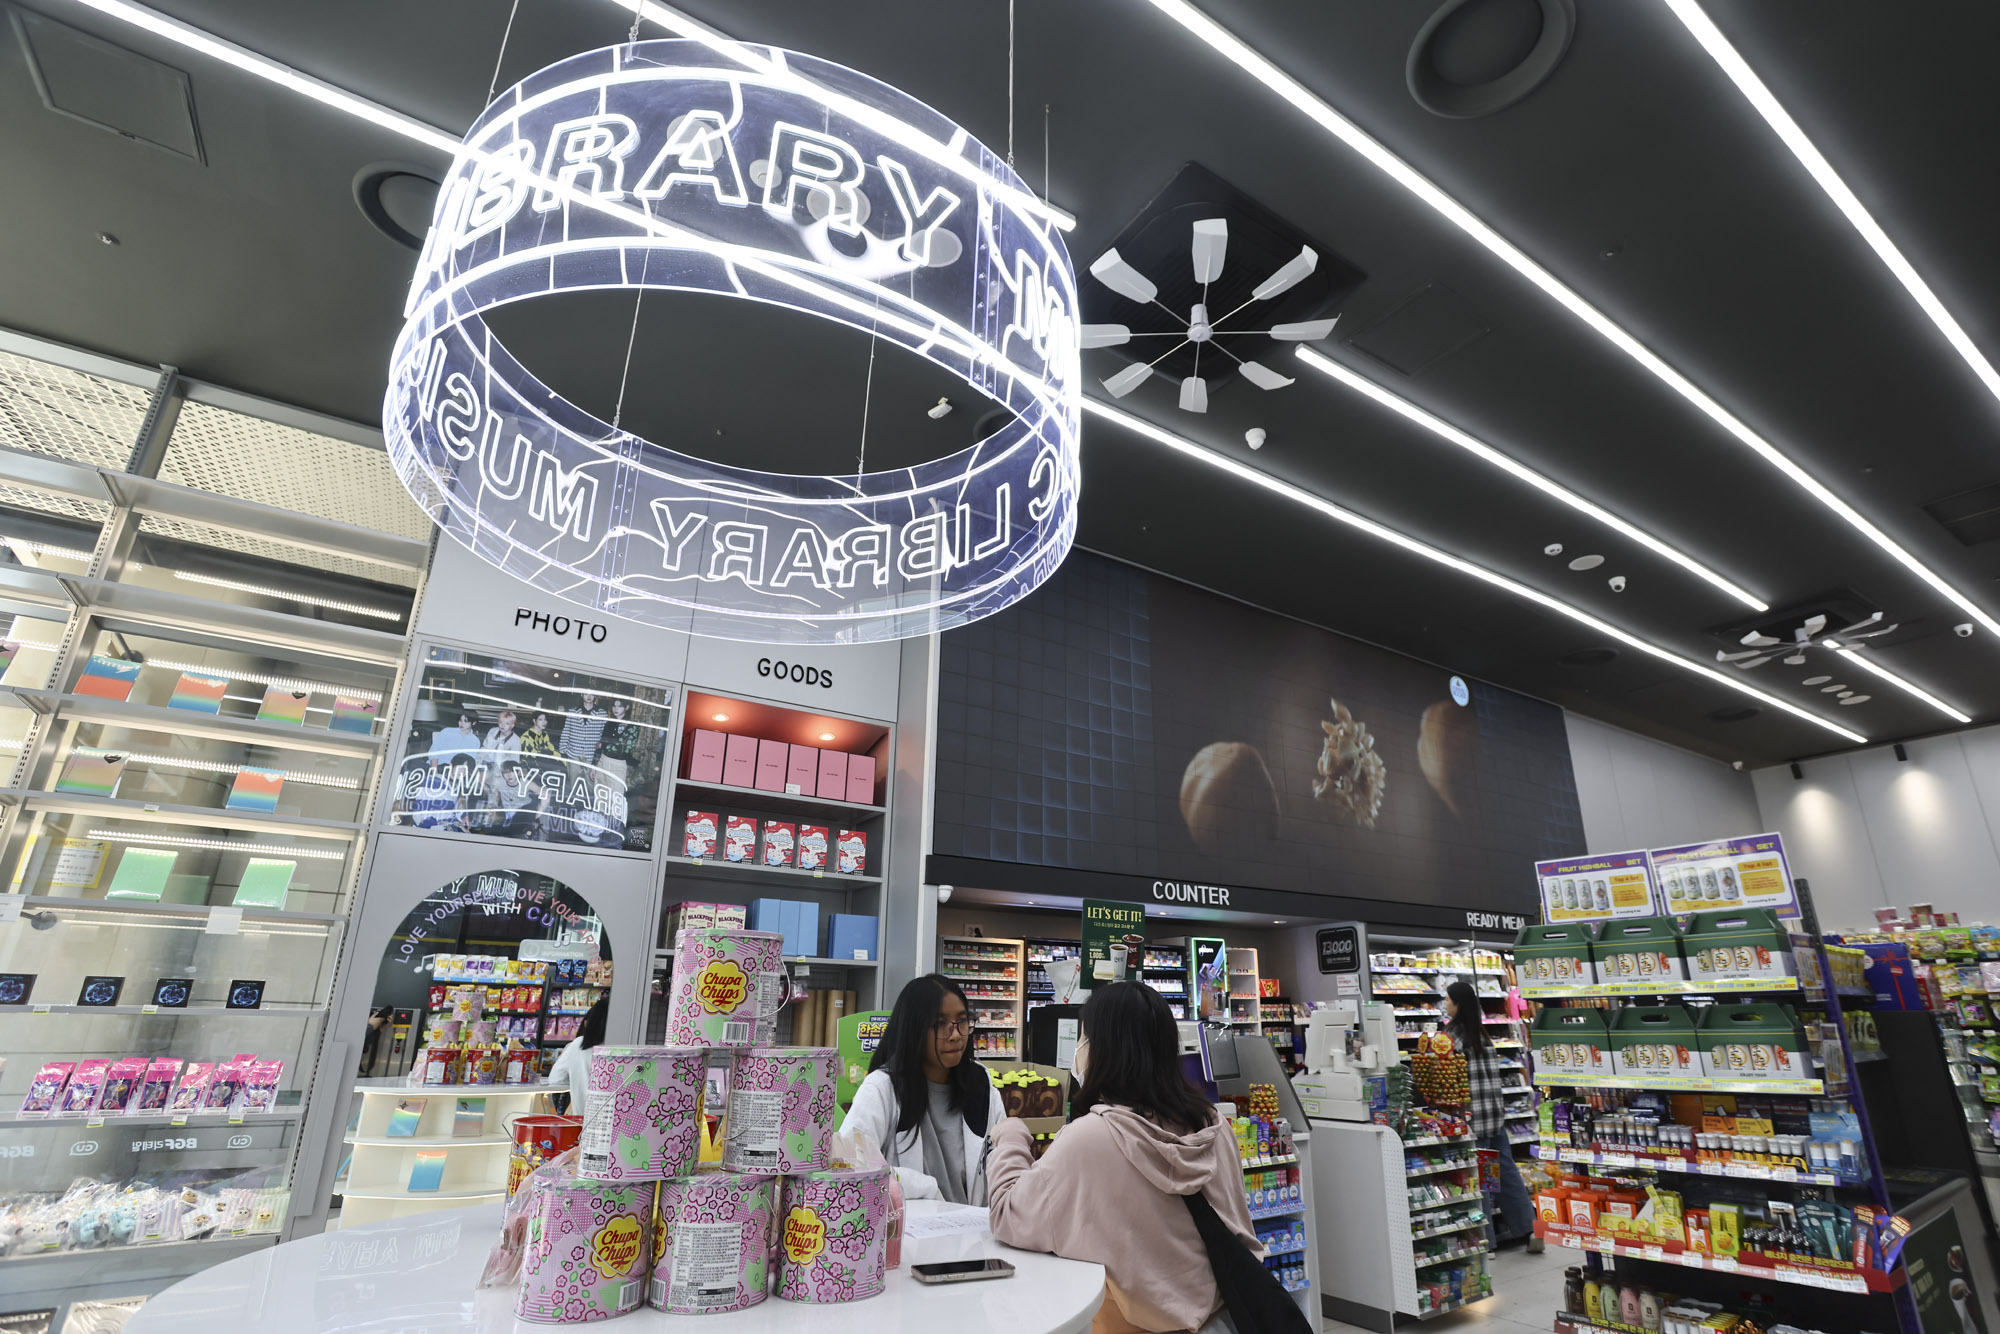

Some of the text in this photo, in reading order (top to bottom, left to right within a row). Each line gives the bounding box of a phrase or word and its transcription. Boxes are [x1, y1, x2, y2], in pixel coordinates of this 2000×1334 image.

[515, 607, 607, 643] PHOTO
[757, 657, 832, 688] GOODS
[1676, 852, 1700, 861] FRUIT
[1756, 842, 1774, 850] SET
[1558, 863, 1578, 873] FRUIT
[1578, 861, 1612, 871] HIGHBALL
[1153, 881, 1230, 906] COUNTER
[483, 902, 555, 927] WITH CU
[688, 914, 713, 922] BLACKPINK
[718, 916, 743, 924] BLACKPINK
[1087, 907, 1142, 922] LET'S GET IT!
[1466, 912, 1499, 929] READY
[395, 887, 604, 972] LOVE YOURSELF LOVE YOUR ARTIST
[704, 972, 742, 989] Chupa
[700, 985, 740, 1007] Chups
[787, 1218, 820, 1235] Chupa
[601, 1229, 639, 1248] Chupa
[784, 1232, 817, 1256] Chups
[596, 1245, 636, 1269] Chups
